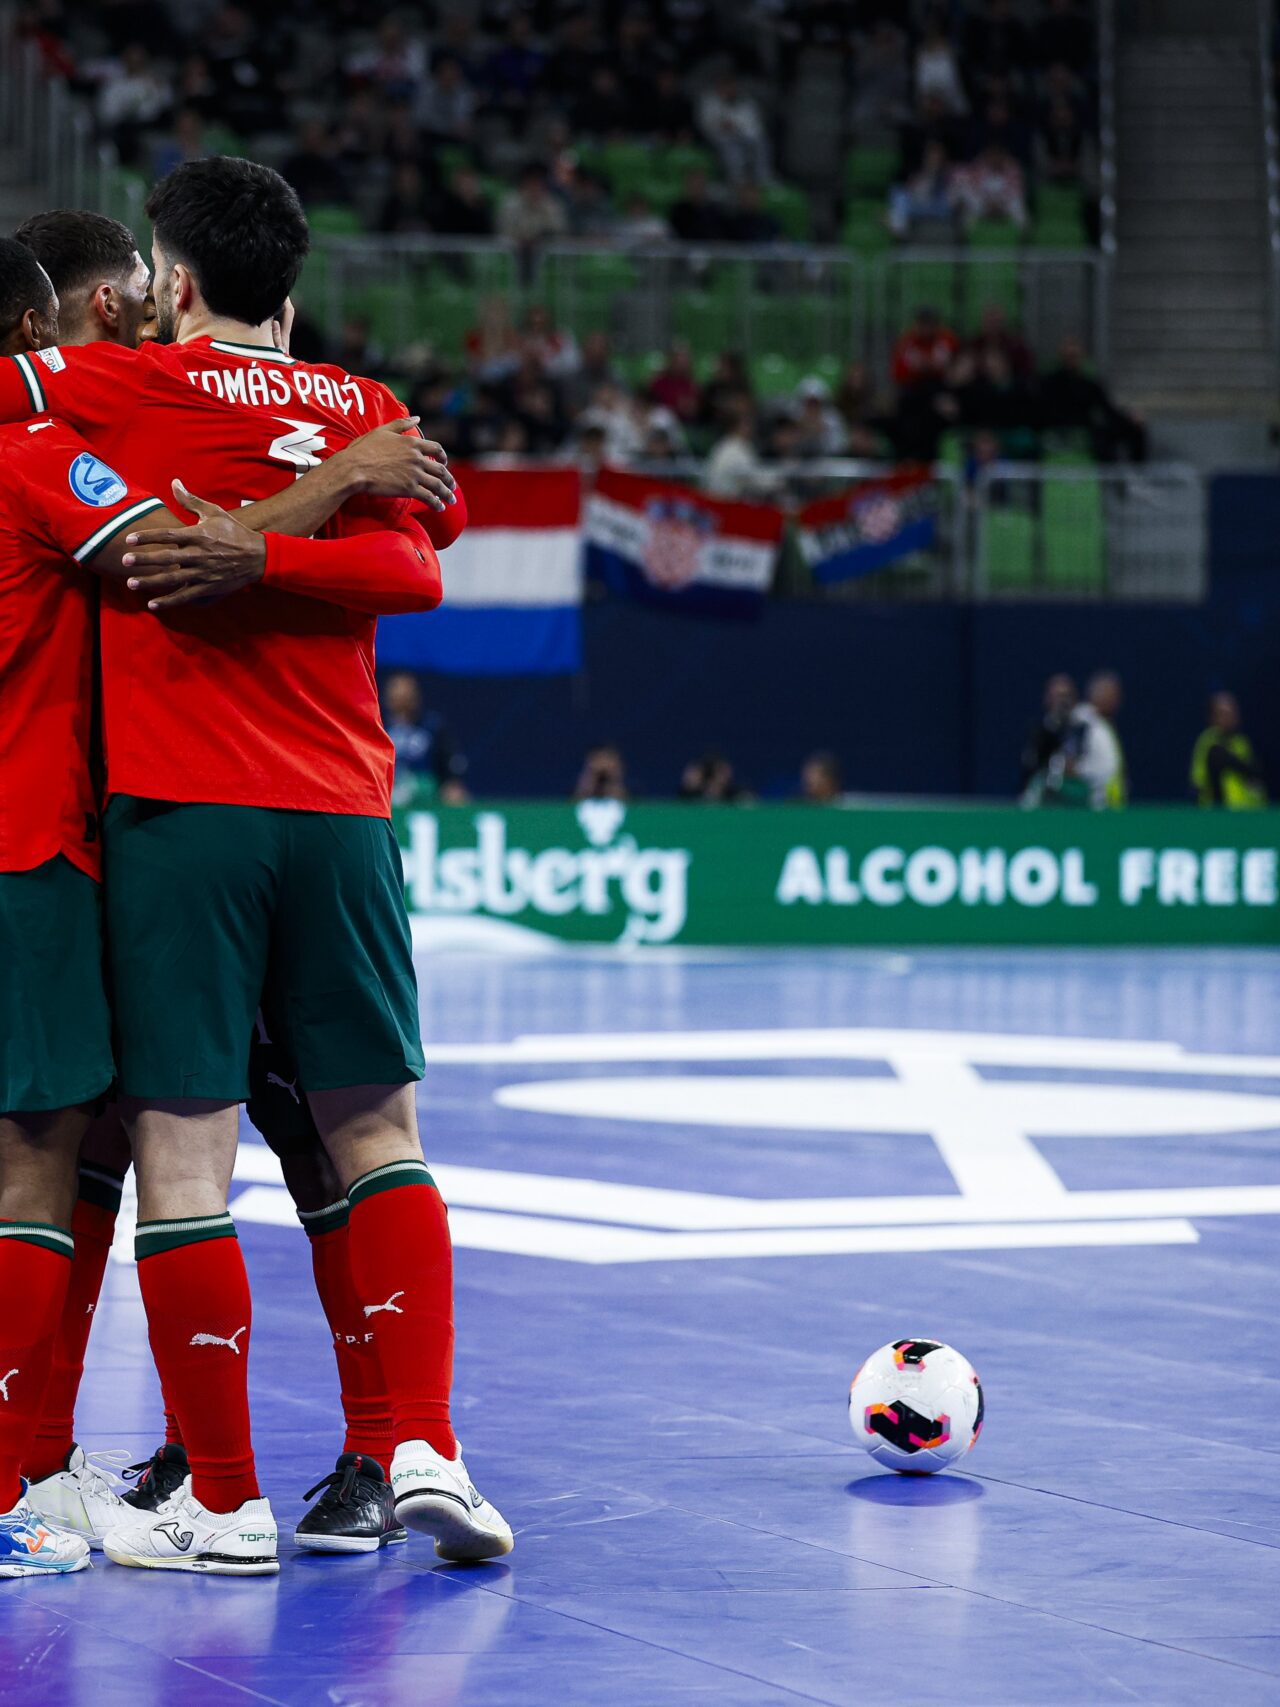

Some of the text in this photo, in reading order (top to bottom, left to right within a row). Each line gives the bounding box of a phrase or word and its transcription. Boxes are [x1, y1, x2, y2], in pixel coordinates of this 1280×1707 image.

[187, 361, 291, 406] TOMÁS
[400, 811, 691, 948] lsberg
[776, 845, 1278, 907] ALCOHOL FREE
[391, 1468, 441, 1486] OP-FLEX
